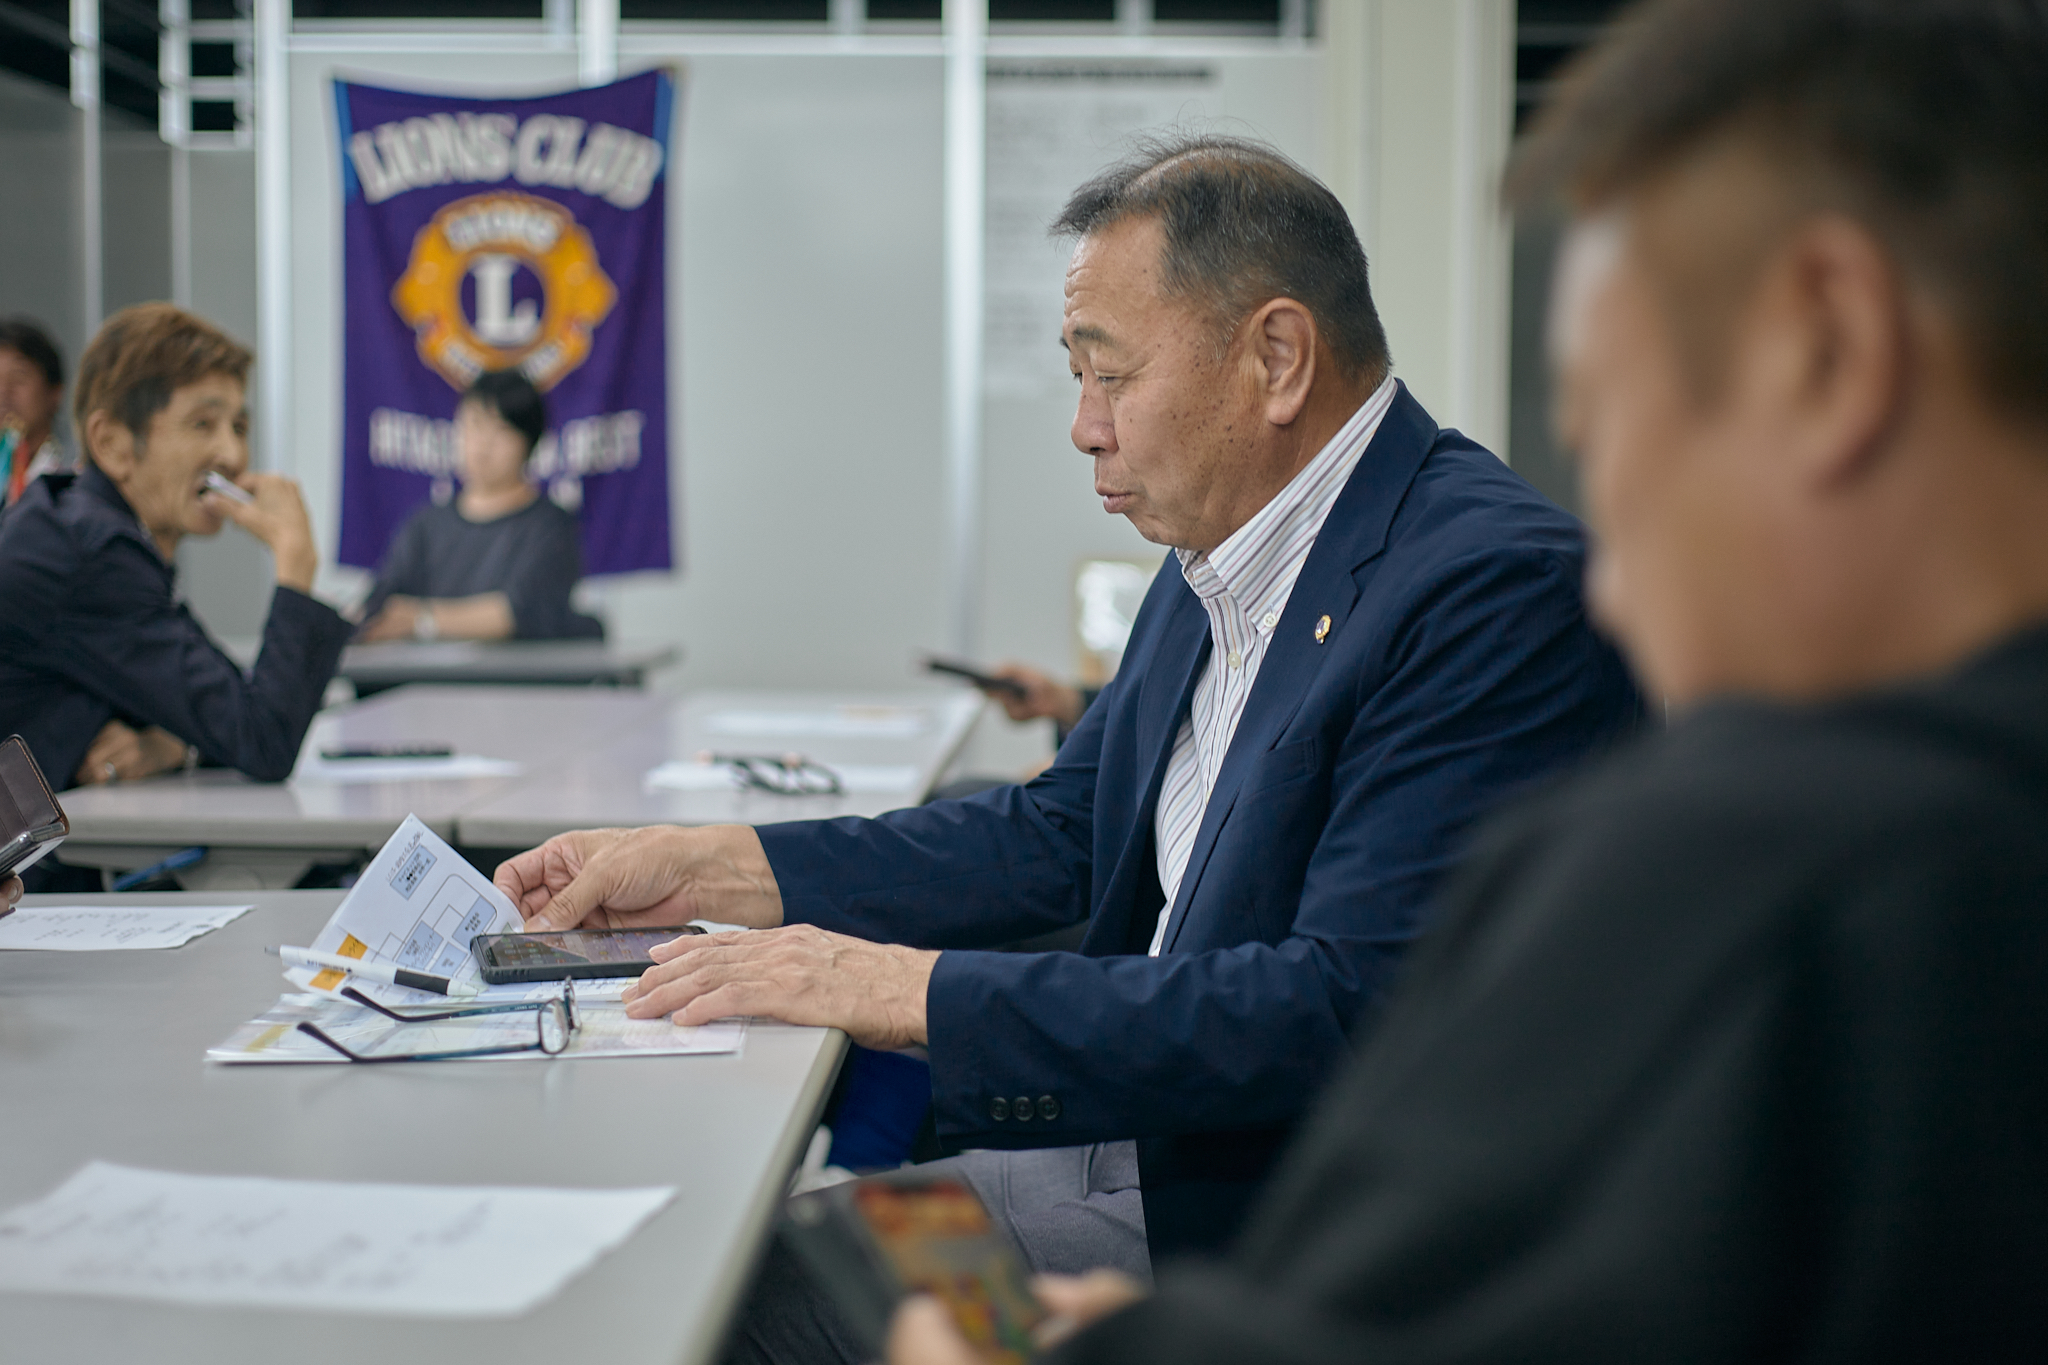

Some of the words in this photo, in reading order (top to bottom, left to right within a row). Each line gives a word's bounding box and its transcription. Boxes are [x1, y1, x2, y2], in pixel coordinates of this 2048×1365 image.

[352, 114, 514, 203] LIONS
[514, 114, 661, 209] CLUB
[472, 256, 537, 341] L
